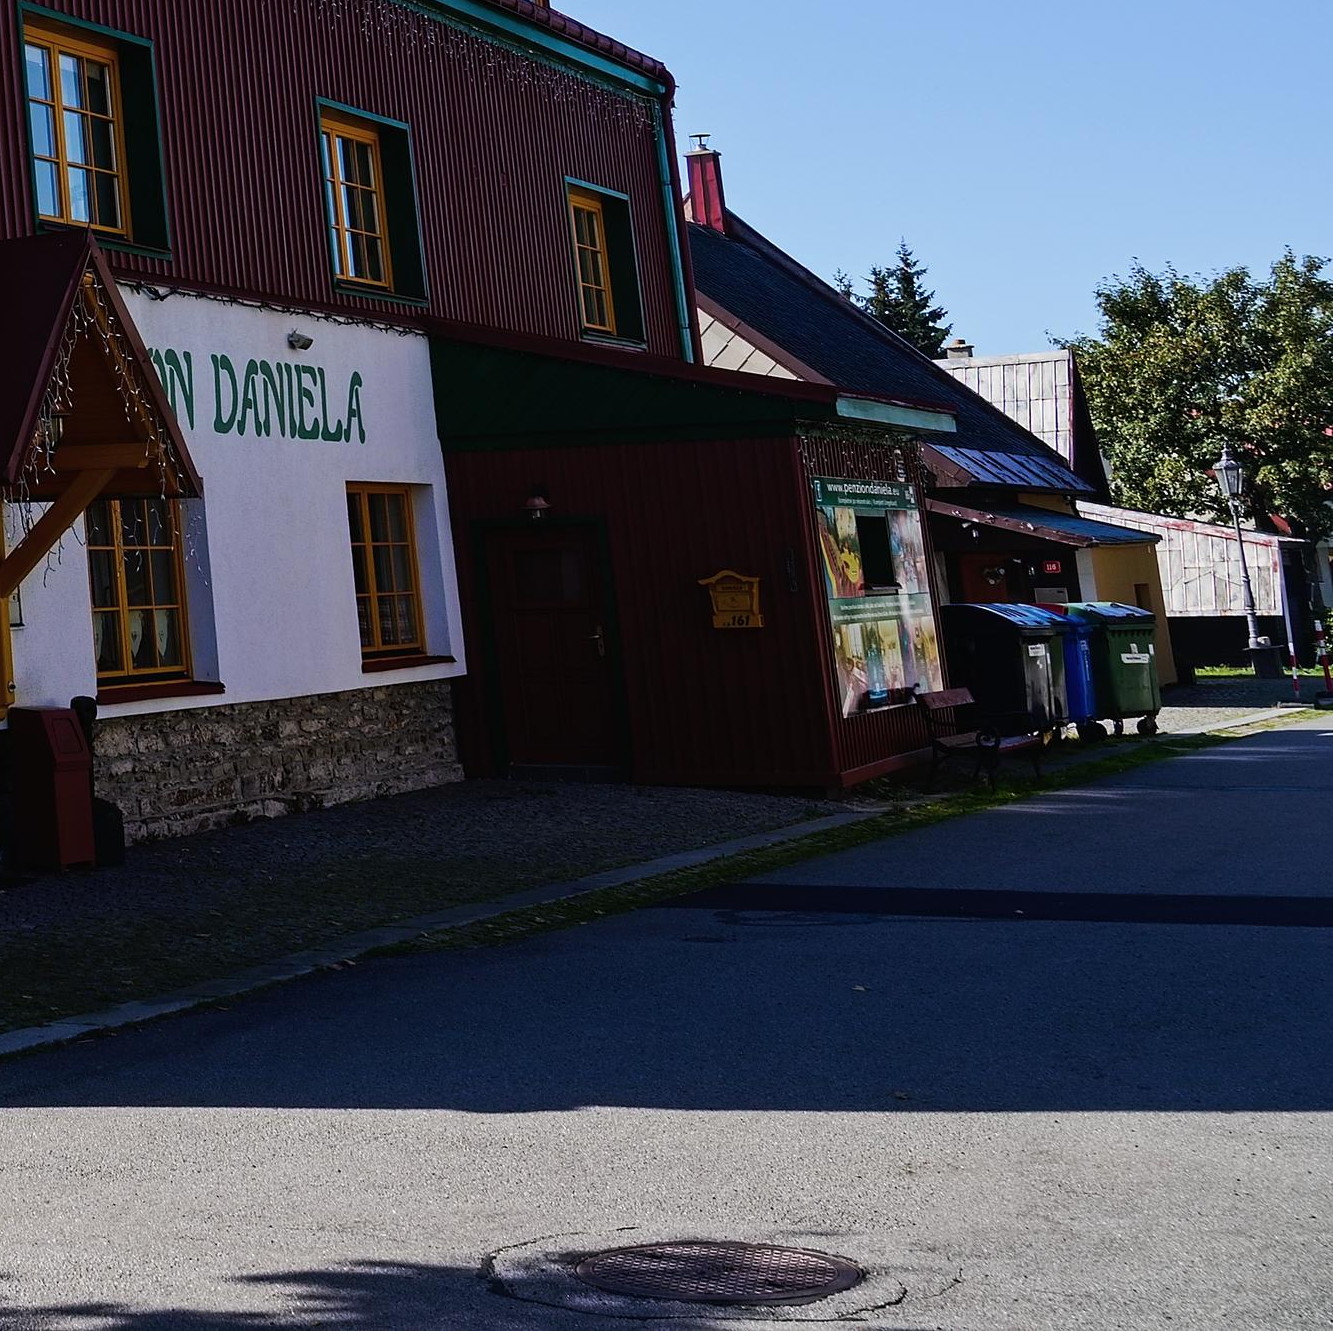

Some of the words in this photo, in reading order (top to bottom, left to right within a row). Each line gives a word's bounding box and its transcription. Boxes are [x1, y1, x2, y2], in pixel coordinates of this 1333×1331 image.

[210, 353, 366, 445] DANIELA
[826, 481, 900, 496] www.penziondaniela.eu
[731, 614, 750, 626] 161
